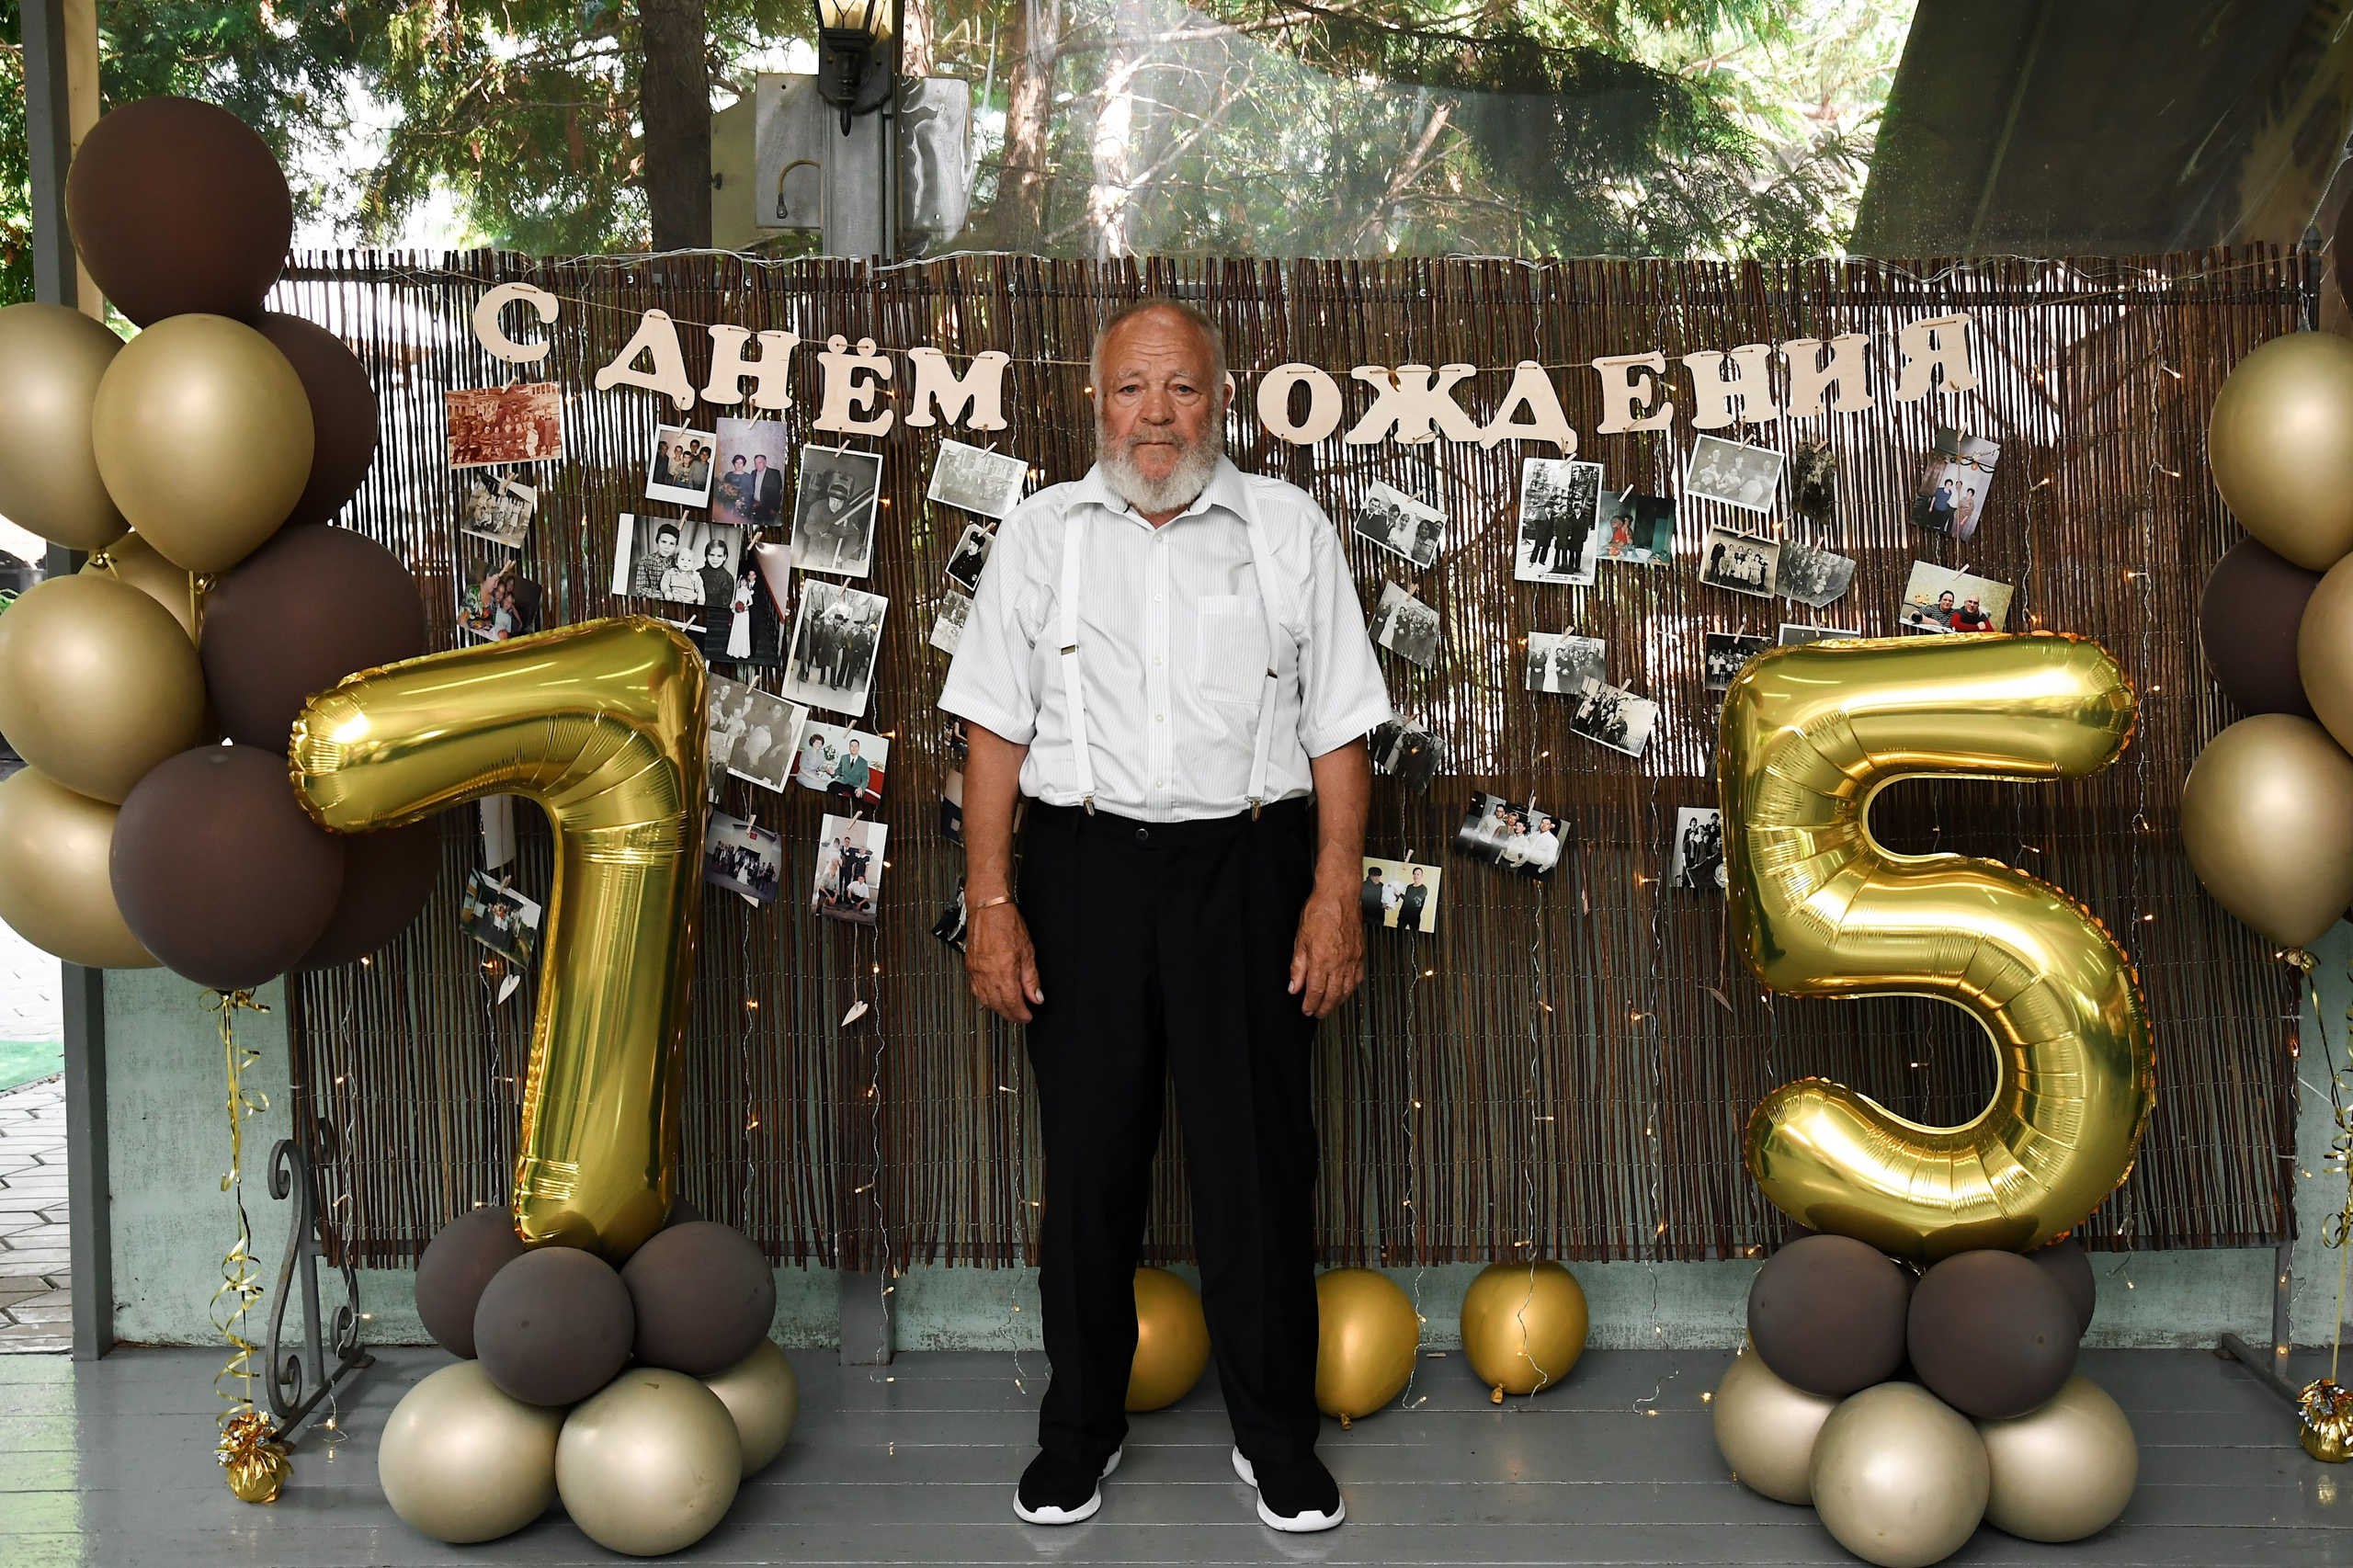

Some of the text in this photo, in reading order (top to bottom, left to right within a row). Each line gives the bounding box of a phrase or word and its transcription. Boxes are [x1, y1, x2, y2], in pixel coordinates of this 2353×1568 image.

[472, 281, 1980, 454] С ДНЁМ ОЖДЕНИЯ
[288, 613, 710, 1260] 7
[1718, 631, 2156, 1261] 5
